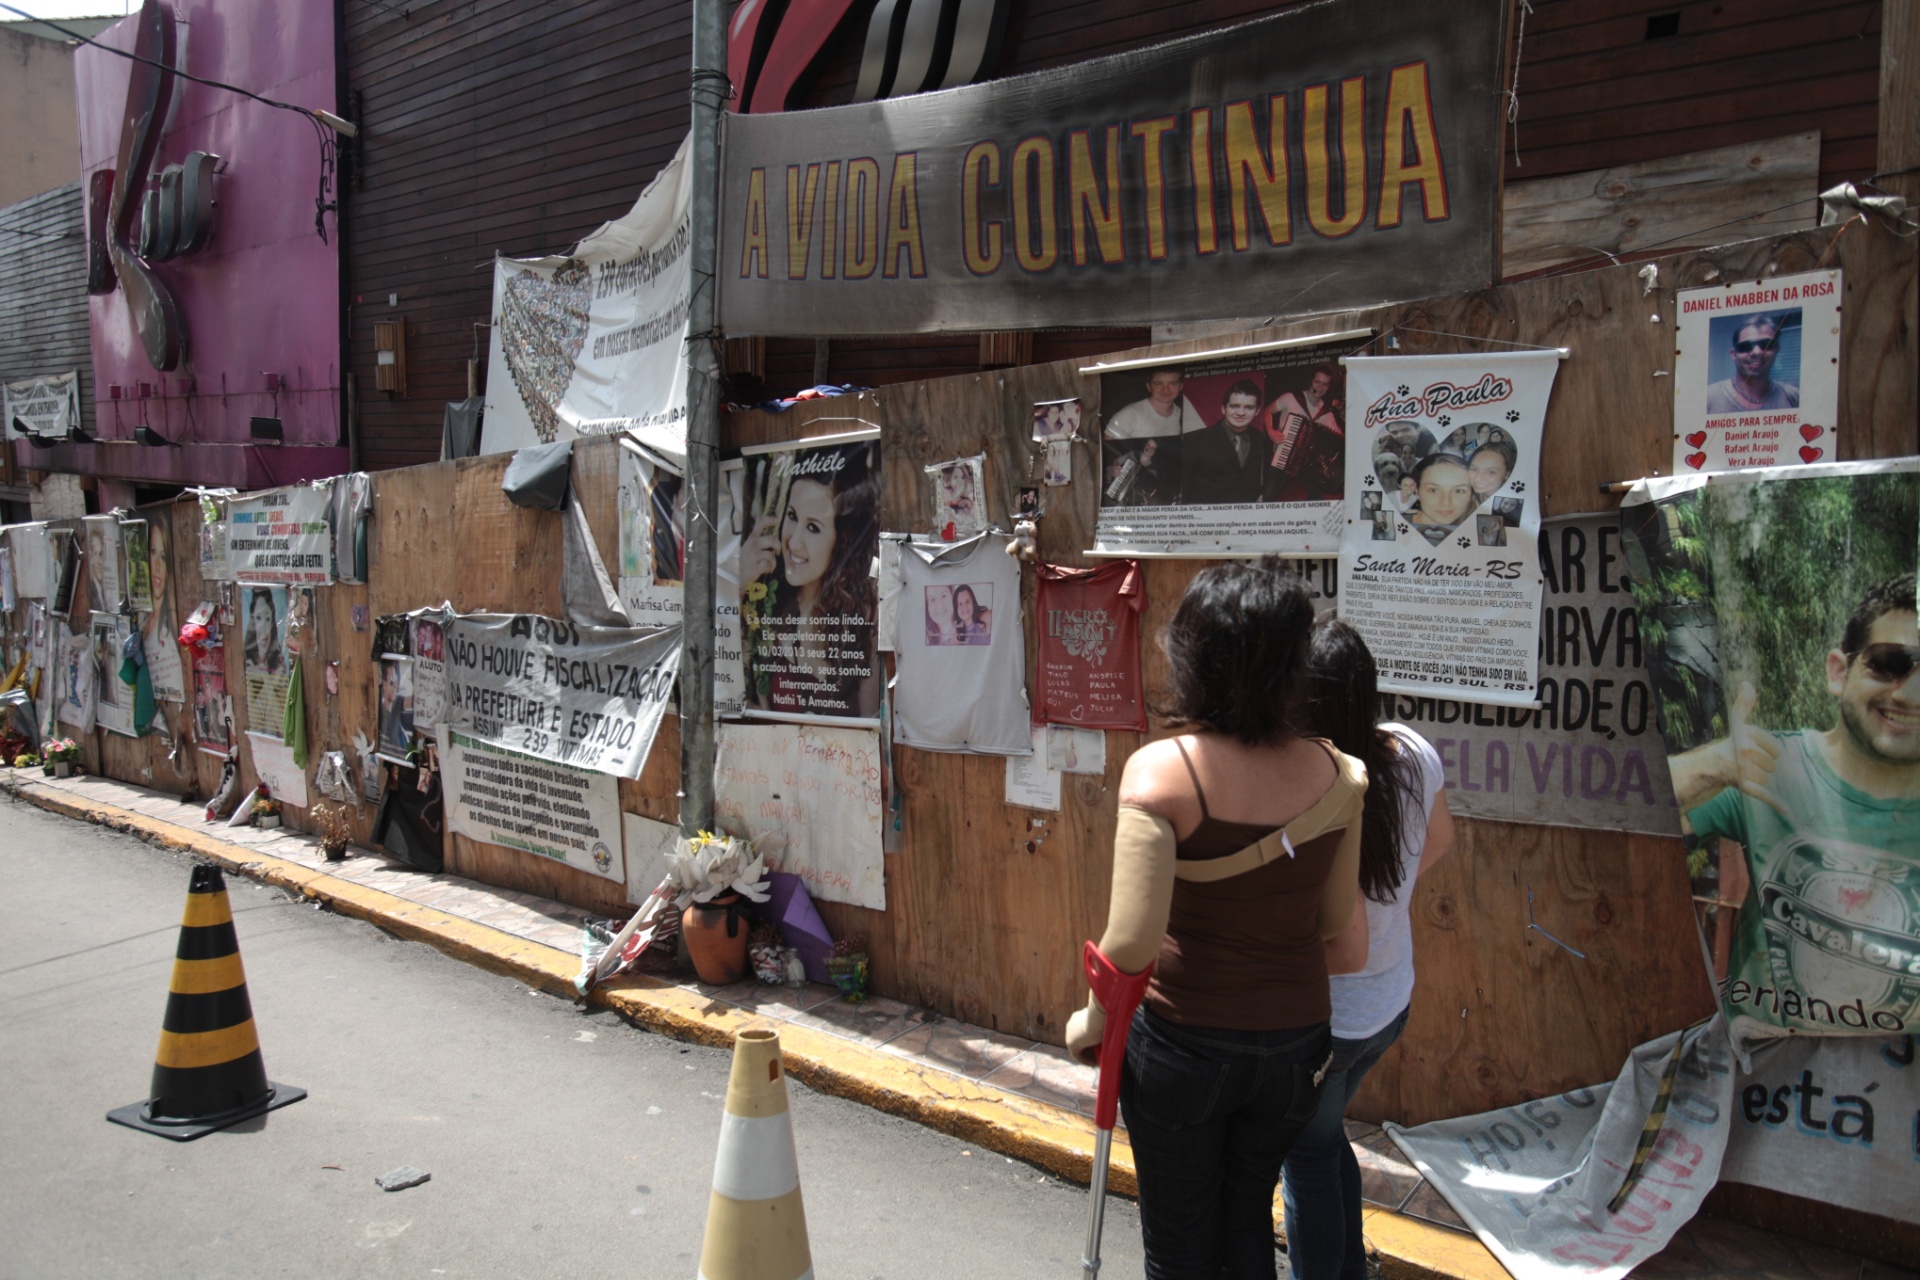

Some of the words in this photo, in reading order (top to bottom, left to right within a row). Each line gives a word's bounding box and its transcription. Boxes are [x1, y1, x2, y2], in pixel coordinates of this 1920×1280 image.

[740, 166, 769, 280] A
[785, 150, 928, 281] VIDA
[961, 59, 1450, 276] CONTINUA
[1683, 297, 1722, 314] DANIEL
[1725, 289, 1779, 309] KNABBEN
[1782, 286, 1799, 300] DA
[1802, 281, 1834, 298] ROSA
[1367, 393, 1422, 427] Ana
[1425, 375, 1508, 415] Paula
[1705, 417, 1737, 429] AMIGOS
[1739, 416, 1760, 427] PARA
[1725, 430, 1750, 441] Daniel
[1752, 429, 1779, 441] Araujo
[1725, 444, 1750, 455] Rafael
[1752, 443, 1779, 454] Araujo
[1728, 457, 1746, 467] Vera
[1748, 456, 1775, 467] Araujo
[1353, 554, 1405, 574] Santa
[1412, 556, 1471, 577] Maria
[1485, 560, 1524, 580] RS
[761, 614, 782, 625] dona
[785, 614, 807, 625] desse
[809, 613, 840, 626] sorriso
[510, 615, 580, 647] AQUI
[762, 630, 776, 641] Ela
[777, 630, 826, 644] completaria
[828, 633, 840, 642] no
[841, 631, 856, 643] dia
[806, 649, 826, 659] seus
[828, 647, 839, 659] 22
[841, 650, 865, 660] anos
[449, 633, 477, 669] NÃO
[482, 645, 535, 681] HOUVE
[543, 655, 673, 705] FISCALIZAÇÃO
[760, 661, 787, 673] acabou
[789, 662, 813, 674] tendo
[818, 666, 837, 676] seus
[838, 664, 872, 677] sonhos
[1378, 658, 1389, 668] QUE
[1395, 660, 1412, 671] MORTE
[1413, 661, 1421, 672] DE
[1455, 664, 1467, 676] NÃO
[1468, 666, 1488, 679] TENHA
[1489, 667, 1503, 679] SIDO
[1504, 668, 1513, 680] EM
[779, 677, 840, 694] interrompidos.
[1393, 671, 1428, 681] RIOS
[1433, 676, 1454, 684] DO
[1459, 678, 1489, 688] SUL
[1504, 682, 1526, 691] RS
[773, 693, 796, 706] Nathi
[797, 695, 807, 706] Te
[808, 695, 850, 710] Amamos.
[450, 681, 463, 708] DA
[466, 686, 545, 731] PREFEITURA
[550, 706, 562, 733] E
[569, 709, 636, 752] ESTADO.
[473, 716, 504, 741] ASSINA
[522, 728, 549, 754] 239
[471, 768, 482, 779] ser
[482, 769, 513, 787] cuidadora
[514, 776, 524, 789] da
[524, 778, 538, 792] vida
[500, 758, 514, 772] toda
[520, 763, 554, 781] sociedade
[554, 767, 590, 789] brasileira
[1525, 740, 1656, 807] VIDA
[500, 788, 521, 803] ações
[511, 804, 521, 817] de
[502, 818, 515, 831] dos
[537, 827, 549, 839] em
[1743, 1069, 1875, 1144] está
